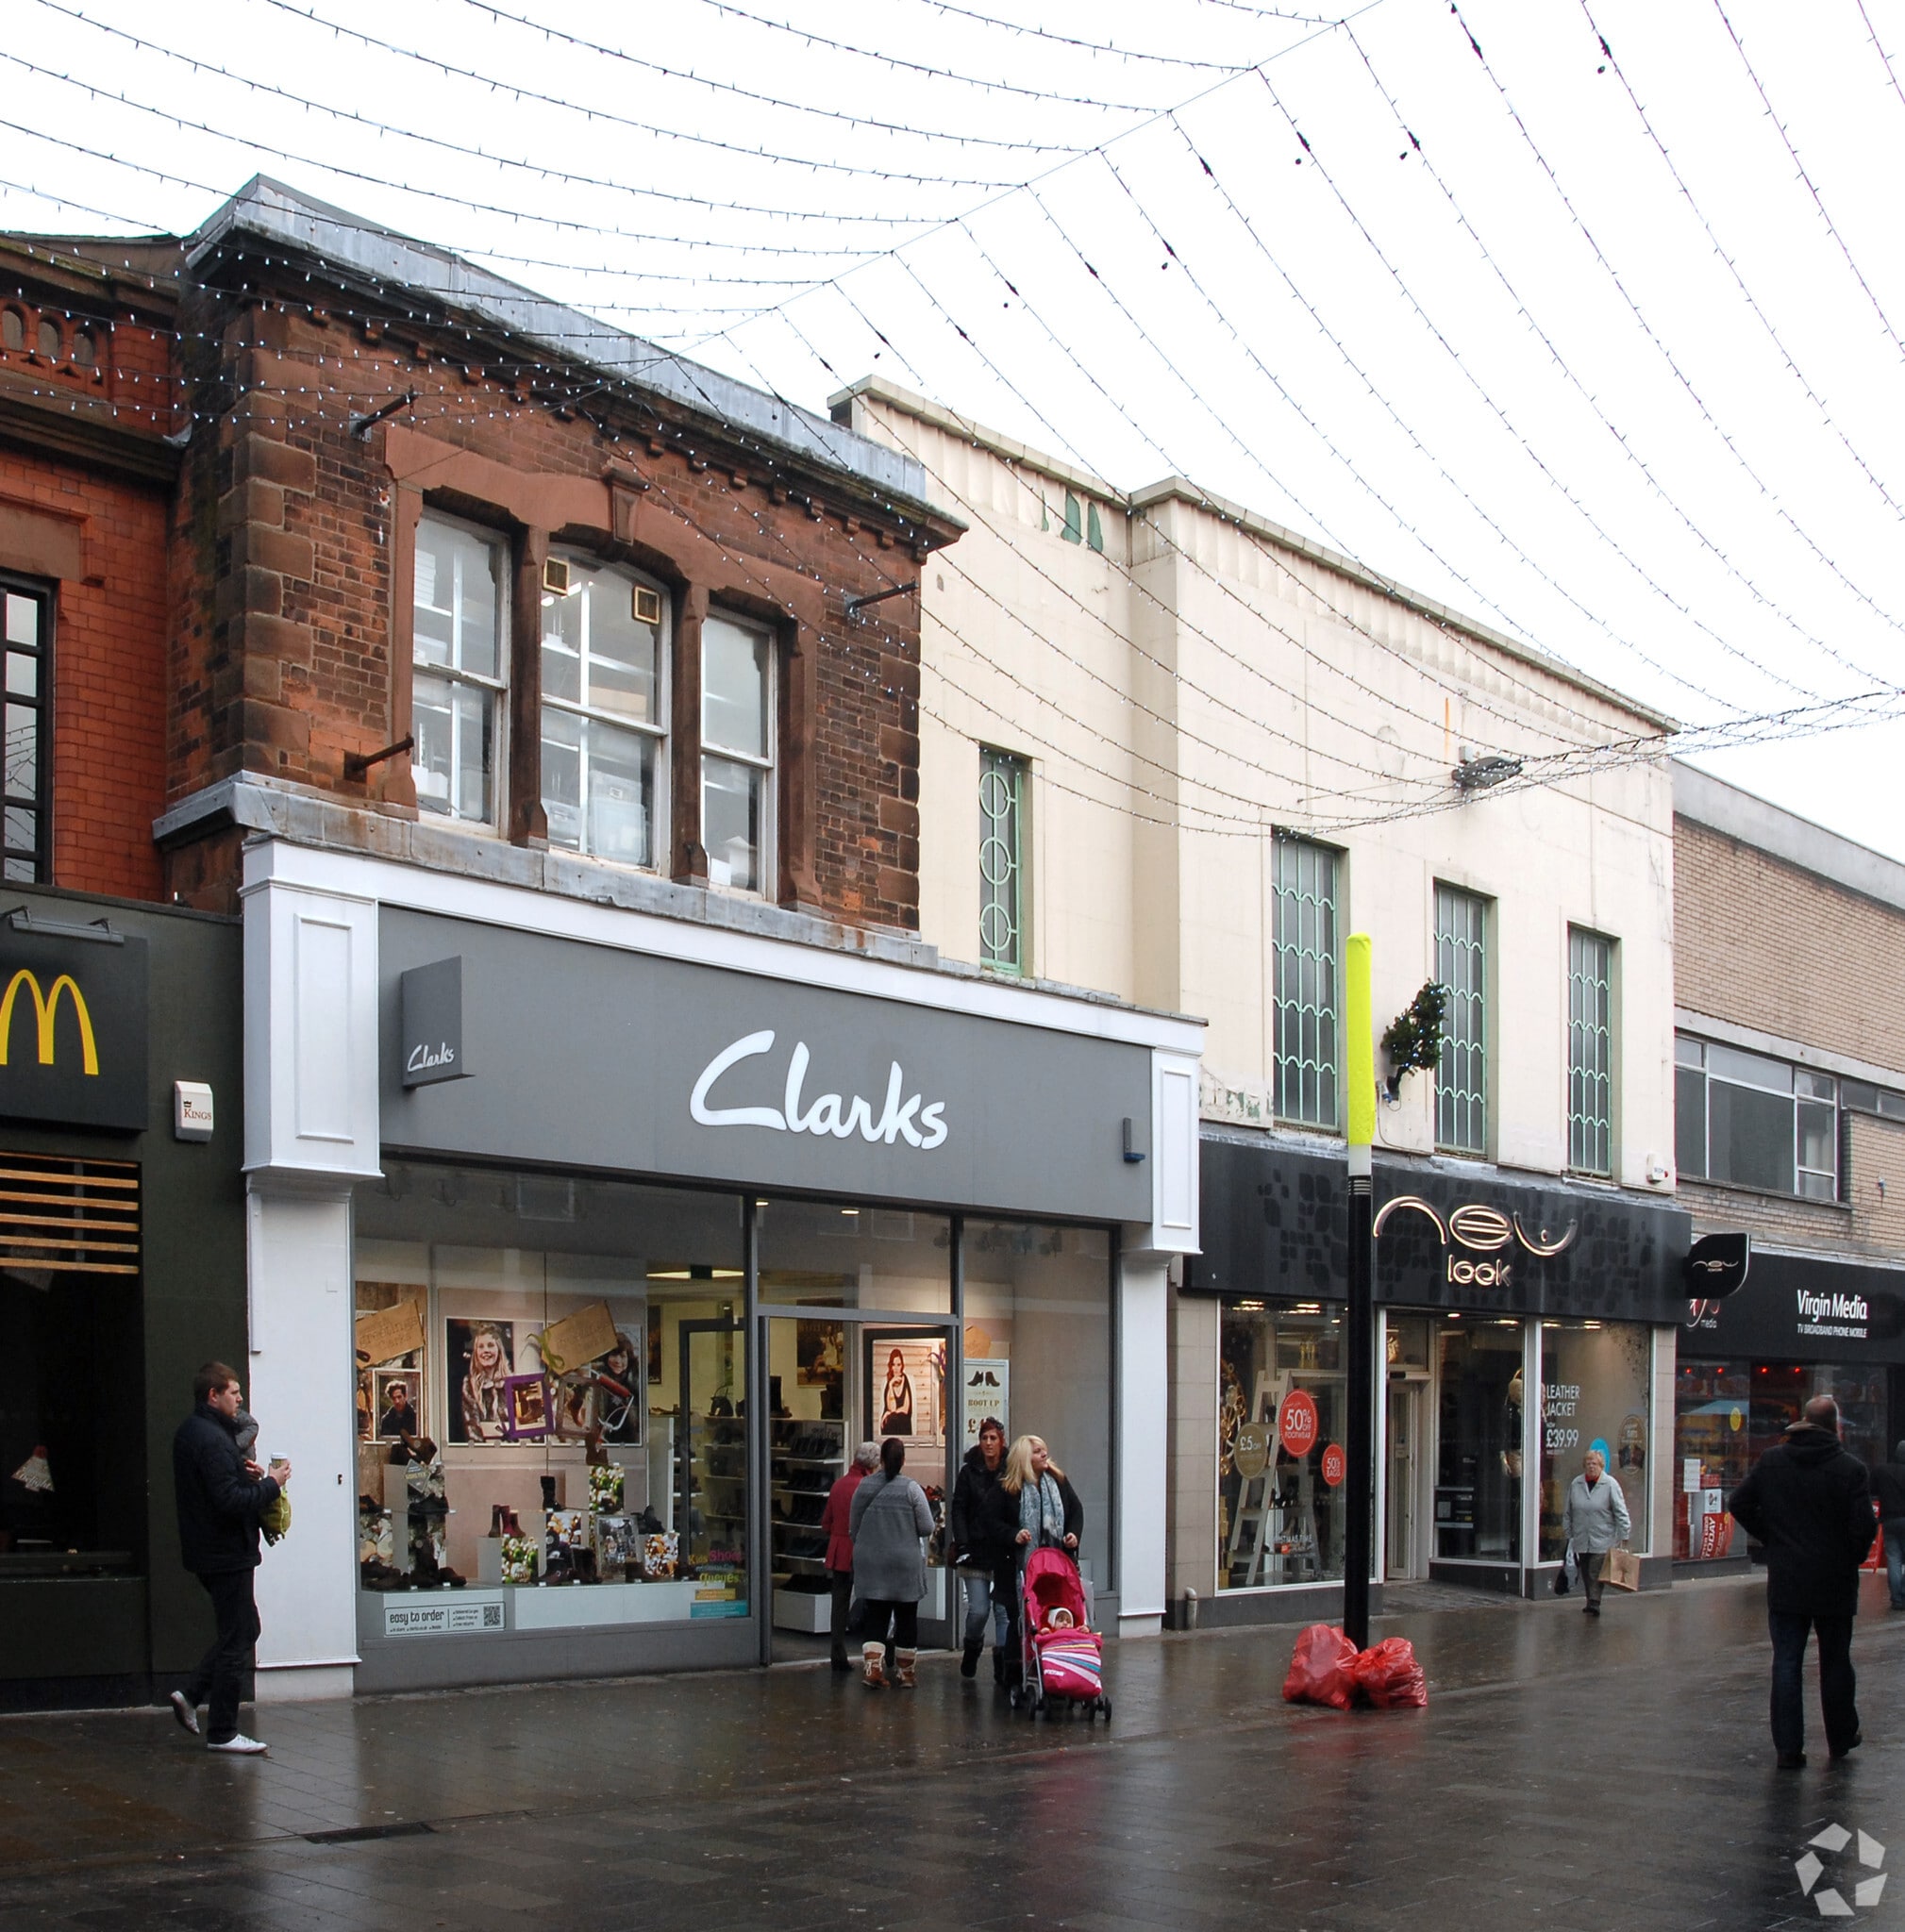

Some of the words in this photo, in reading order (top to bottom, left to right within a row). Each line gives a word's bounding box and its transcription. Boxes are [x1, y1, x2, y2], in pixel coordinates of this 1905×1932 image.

[407, 1041, 455, 1073] Clarks
[690, 1029, 948, 1150] Clarks
[1447, 1254, 1512, 1288] look
[1797, 1289, 1830, 1323] Virgin
[1831, 1292, 1868, 1320] Media
[1804, 1324, 1832, 1336] BROADBAND
[1833, 1326, 1849, 1337] PHONE
[1546, 1385, 1580, 1400] LEATHER
[1546, 1402, 1576, 1417] JACKET
[1240, 1436, 1253, 1451] £5
[1546, 1428, 1579, 1448] £39.99
[1706, 1516, 1716, 1557] TODAY
[390, 1612, 409, 1626] easy
[410, 1611, 420, 1622] to
[421, 1609, 444, 1622] order
